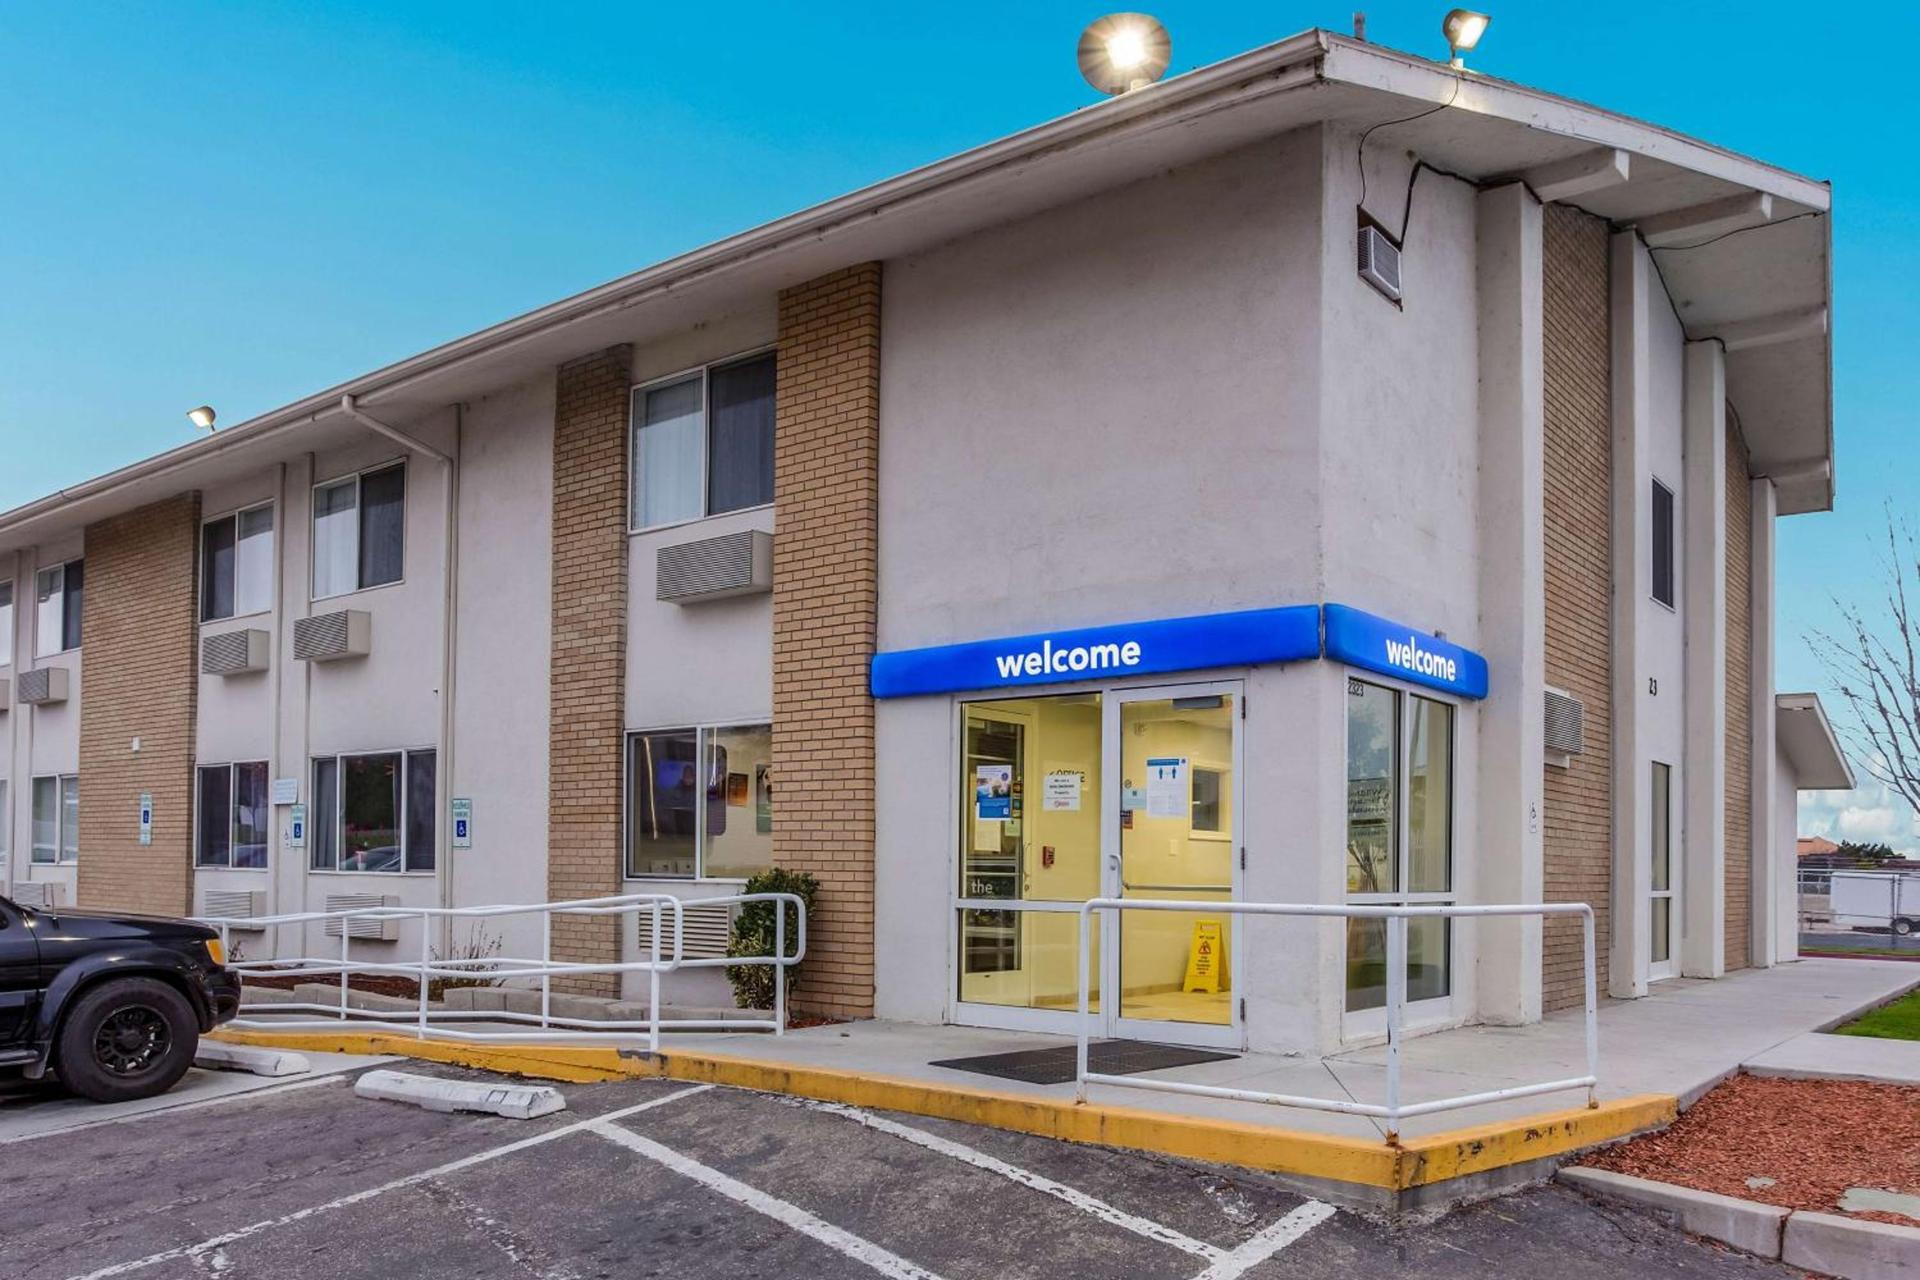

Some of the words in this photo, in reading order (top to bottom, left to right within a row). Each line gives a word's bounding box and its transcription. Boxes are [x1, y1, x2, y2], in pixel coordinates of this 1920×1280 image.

[996, 639, 1141, 678] welcome
[1385, 635, 1456, 682] welcome
[1348, 680, 1364, 697] 2323
[1649, 676, 1657, 696] 23
[971, 878, 993, 894] the
